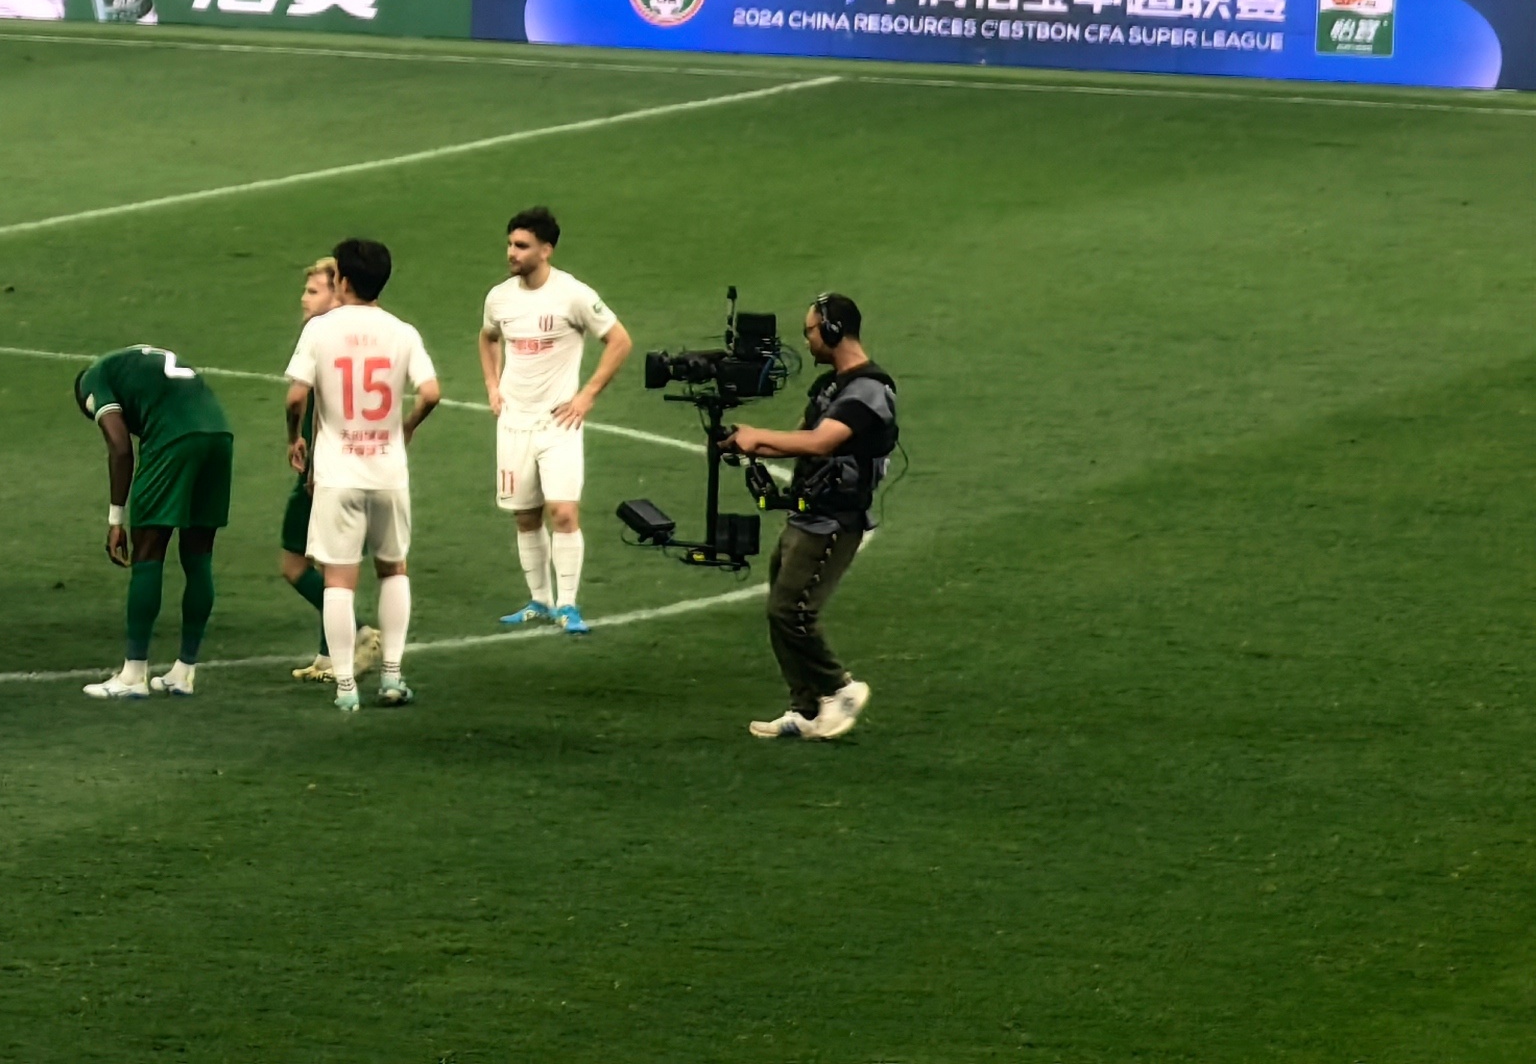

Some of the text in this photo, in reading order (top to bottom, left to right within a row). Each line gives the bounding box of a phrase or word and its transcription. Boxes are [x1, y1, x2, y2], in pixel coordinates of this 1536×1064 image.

[732, 7, 783, 29] 2024
[788, 9, 850, 32] CHINA
[854, 11, 977, 38] RESOURCES
[1084, 23, 1125, 45] CFA
[1128, 24, 1198, 48] SUPER
[1201, 28, 1285, 52] LEAGUE
[333, 356, 393, 421] 15
[500, 468, 515, 495] 11
